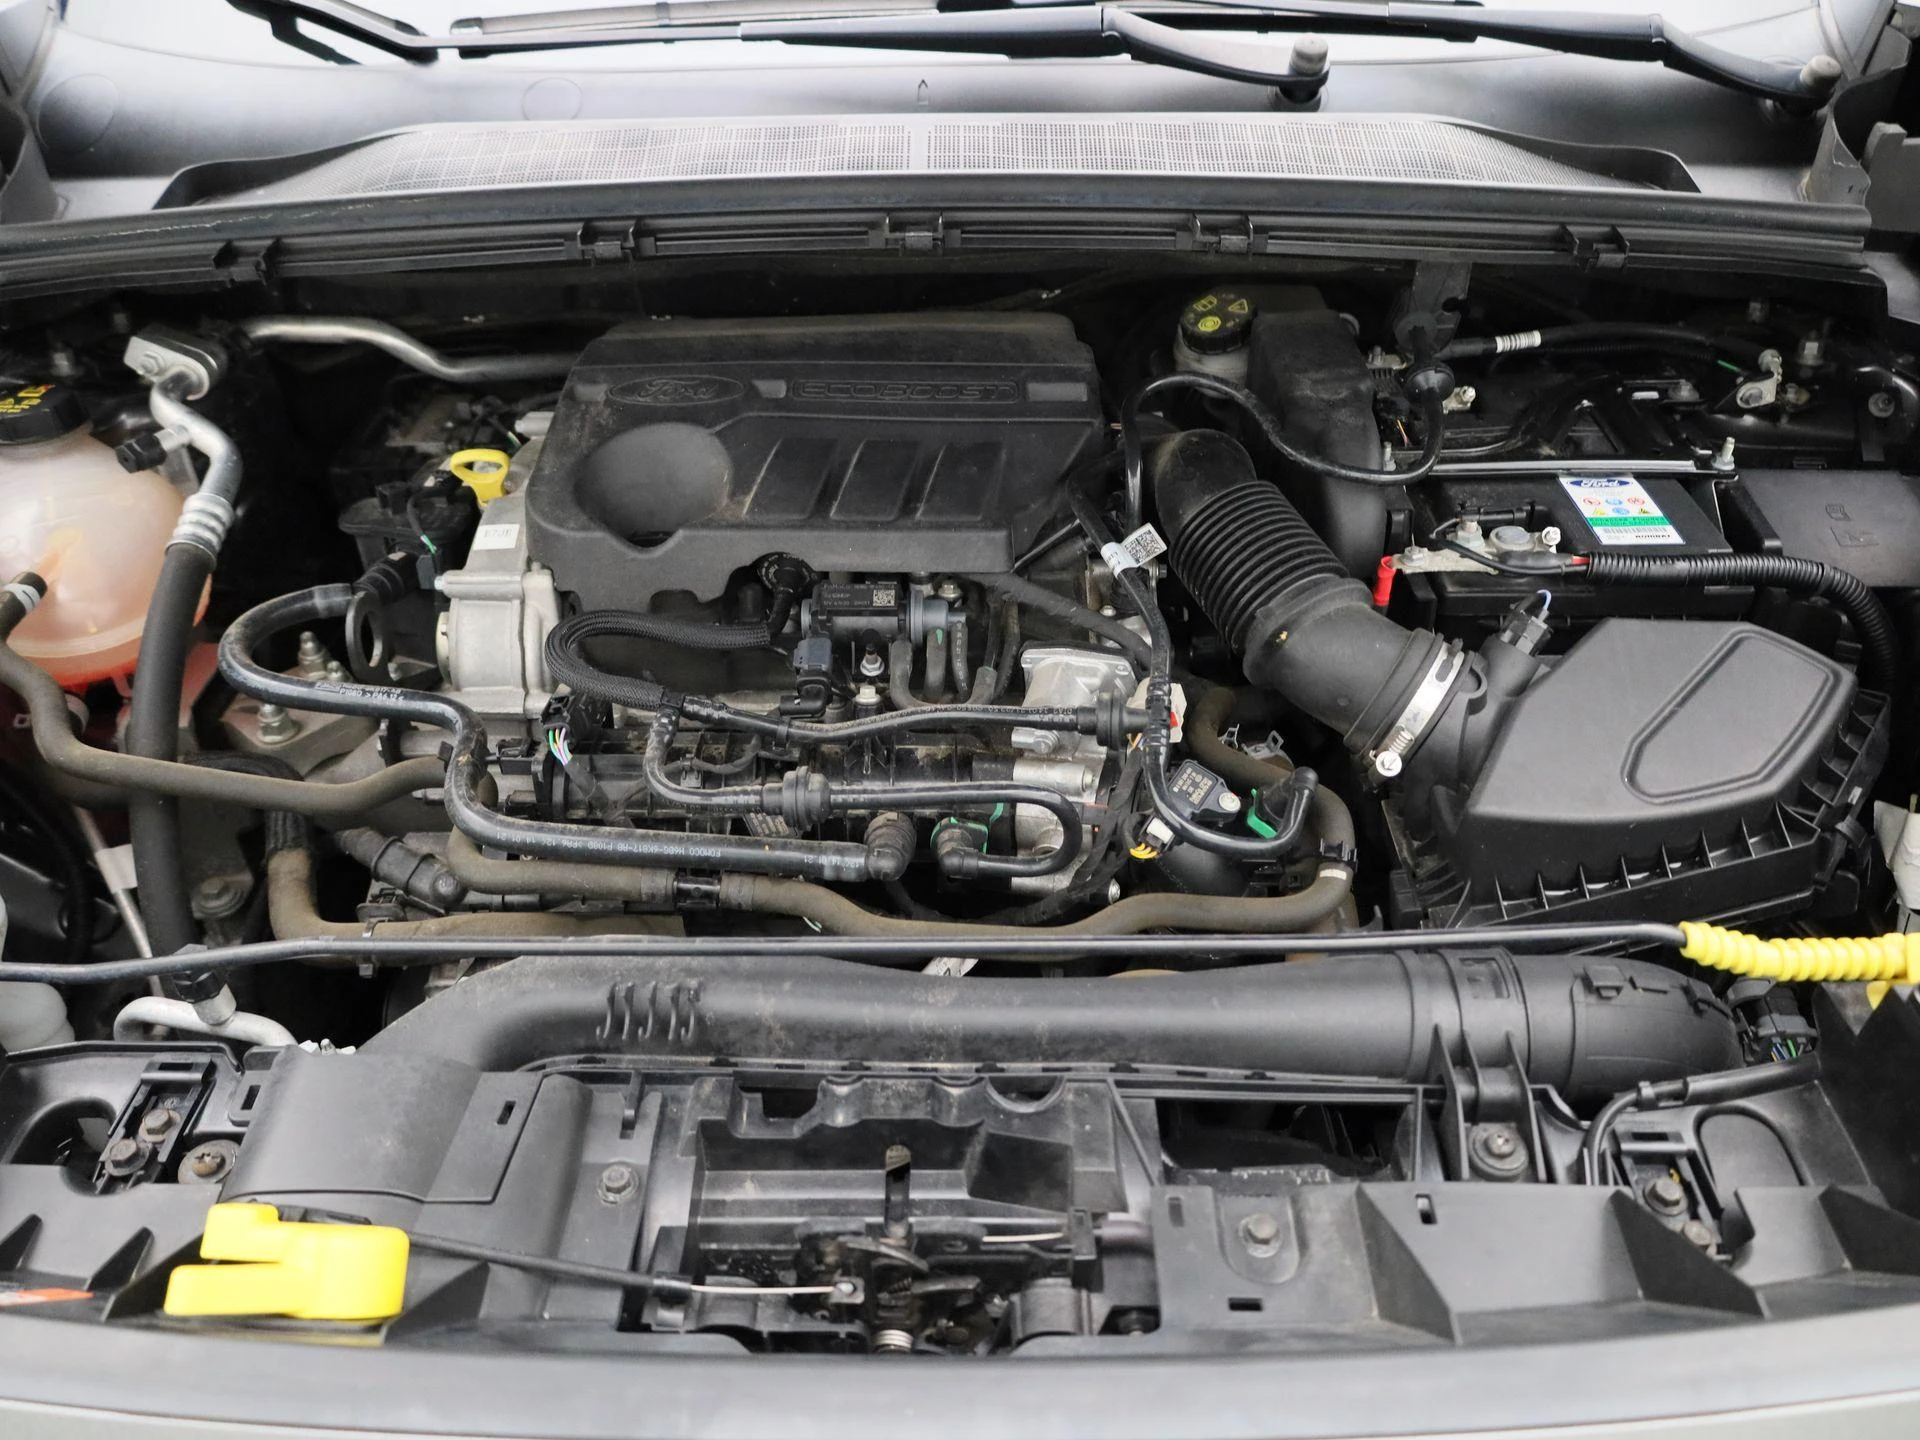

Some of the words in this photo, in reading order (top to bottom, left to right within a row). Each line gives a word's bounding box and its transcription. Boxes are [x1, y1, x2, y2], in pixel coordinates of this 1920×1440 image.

[637, 379, 719, 400] Ford
[800, 383, 1017, 399] ECOBOOST
[689, 846, 721, 857] FOMOCO
